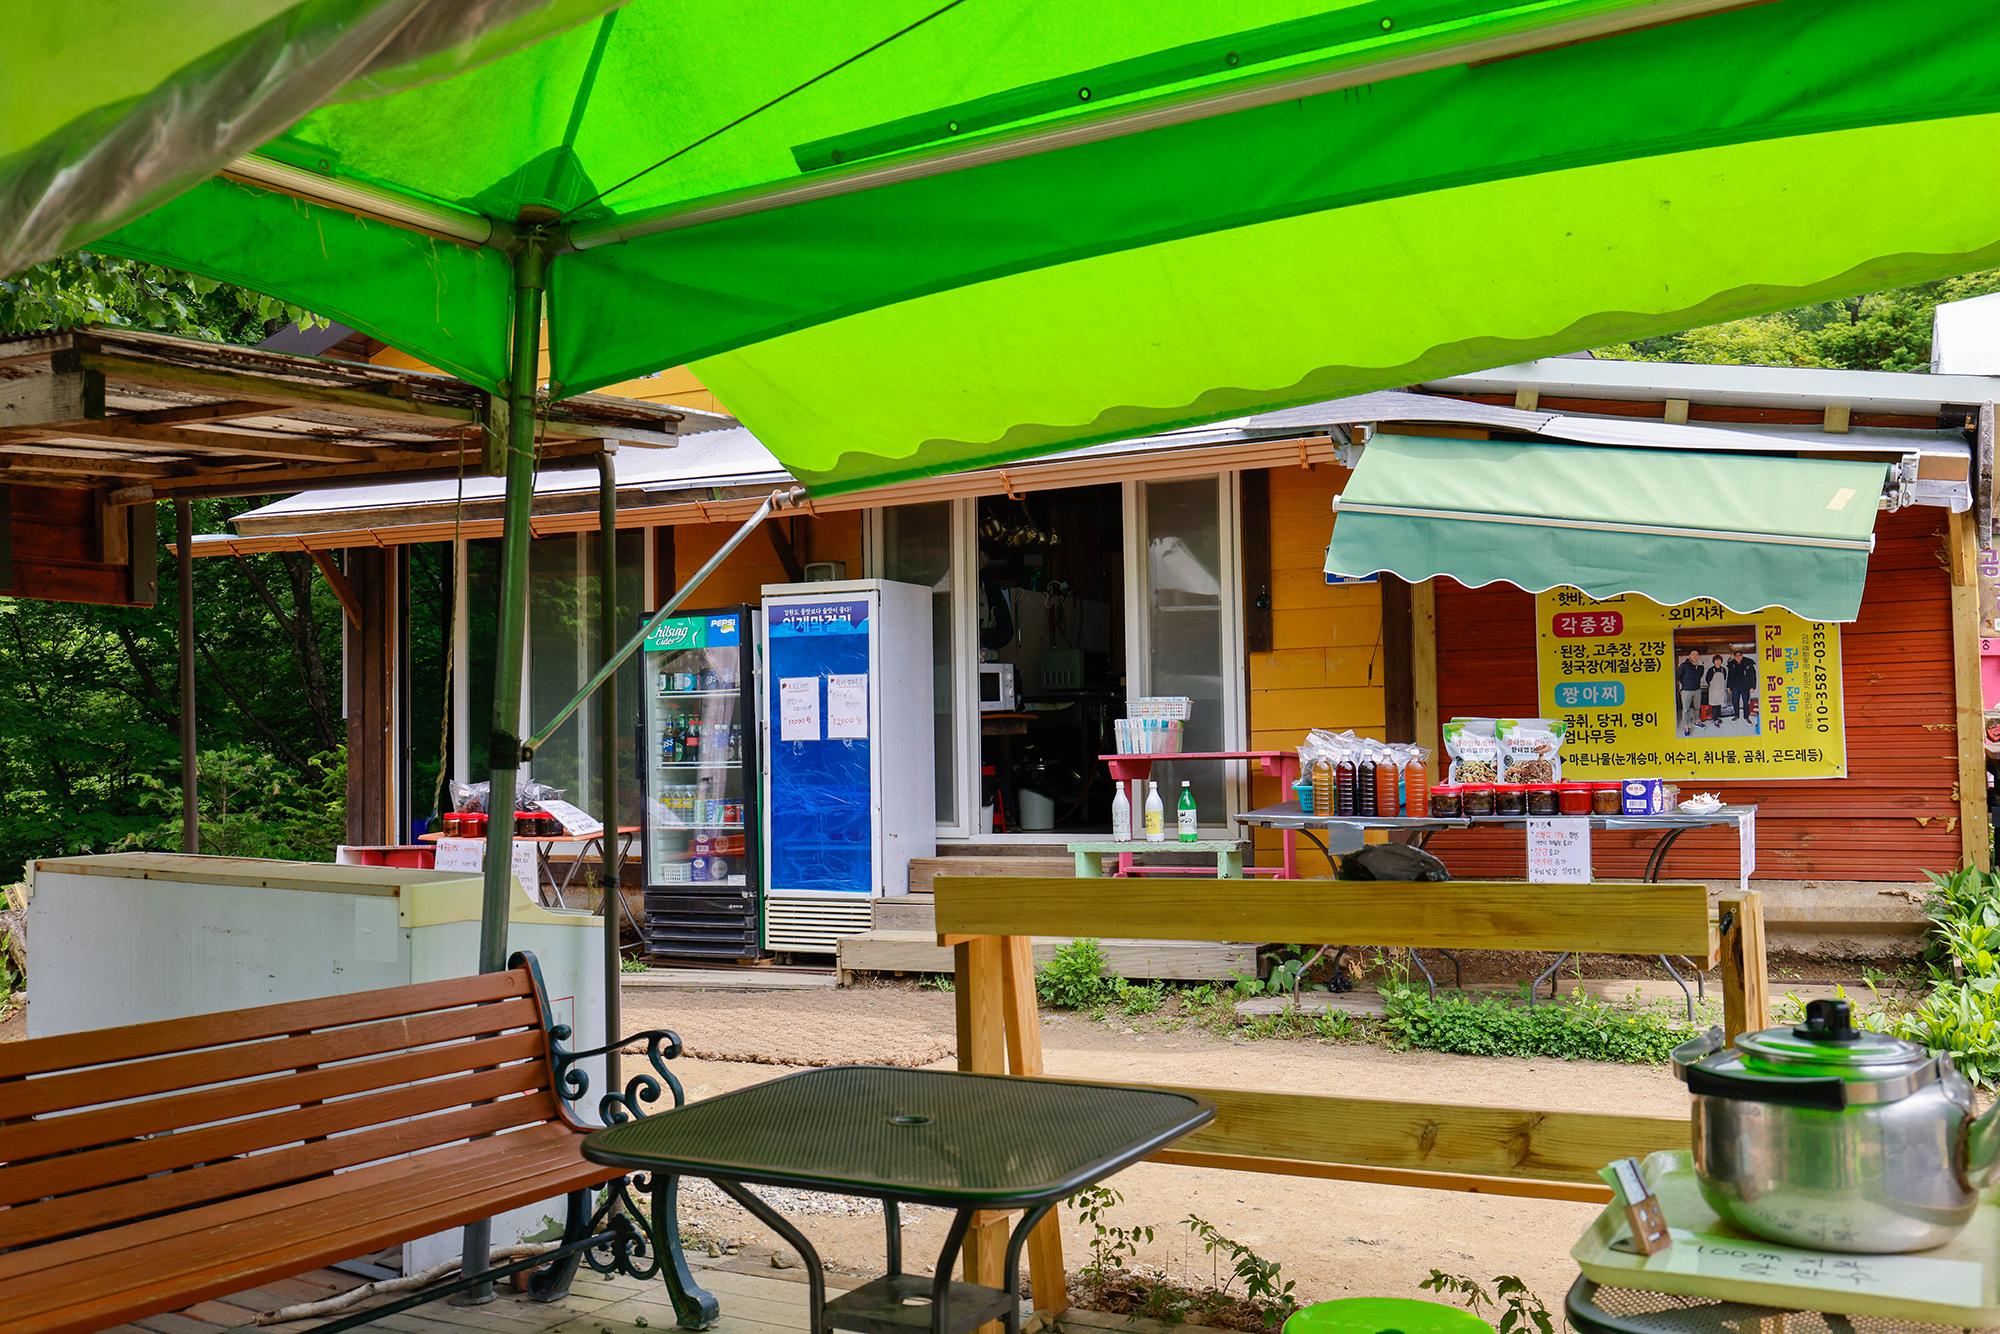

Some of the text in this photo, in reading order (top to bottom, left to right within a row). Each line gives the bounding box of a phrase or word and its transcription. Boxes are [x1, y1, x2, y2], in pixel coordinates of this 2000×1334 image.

[1669, 605, 1724, 621] 오미자차
[711, 619, 735, 627] PEPSI
[1561, 616, 1617, 634] 각종장
[1560, 641, 1666, 658] 된장, 고추장, 간장
[1561, 658, 1661, 675] 청국장(계절상품)
[1813, 623, 1829, 732] 010-3587-0335
[1562, 685, 1618, 704] 짱아찌
[1786, 686, 1801, 712] 매점
[1766, 675, 1785, 733] 곰배령
[1563, 712, 1658, 728] 곰취, 당귀, 명이
[1565, 730, 1617, 744] 엄나무등
[1569, 749, 1823, 766] 마른나물(눈개승마, 어수리, 취나물, 곰취, 곤드레등)
